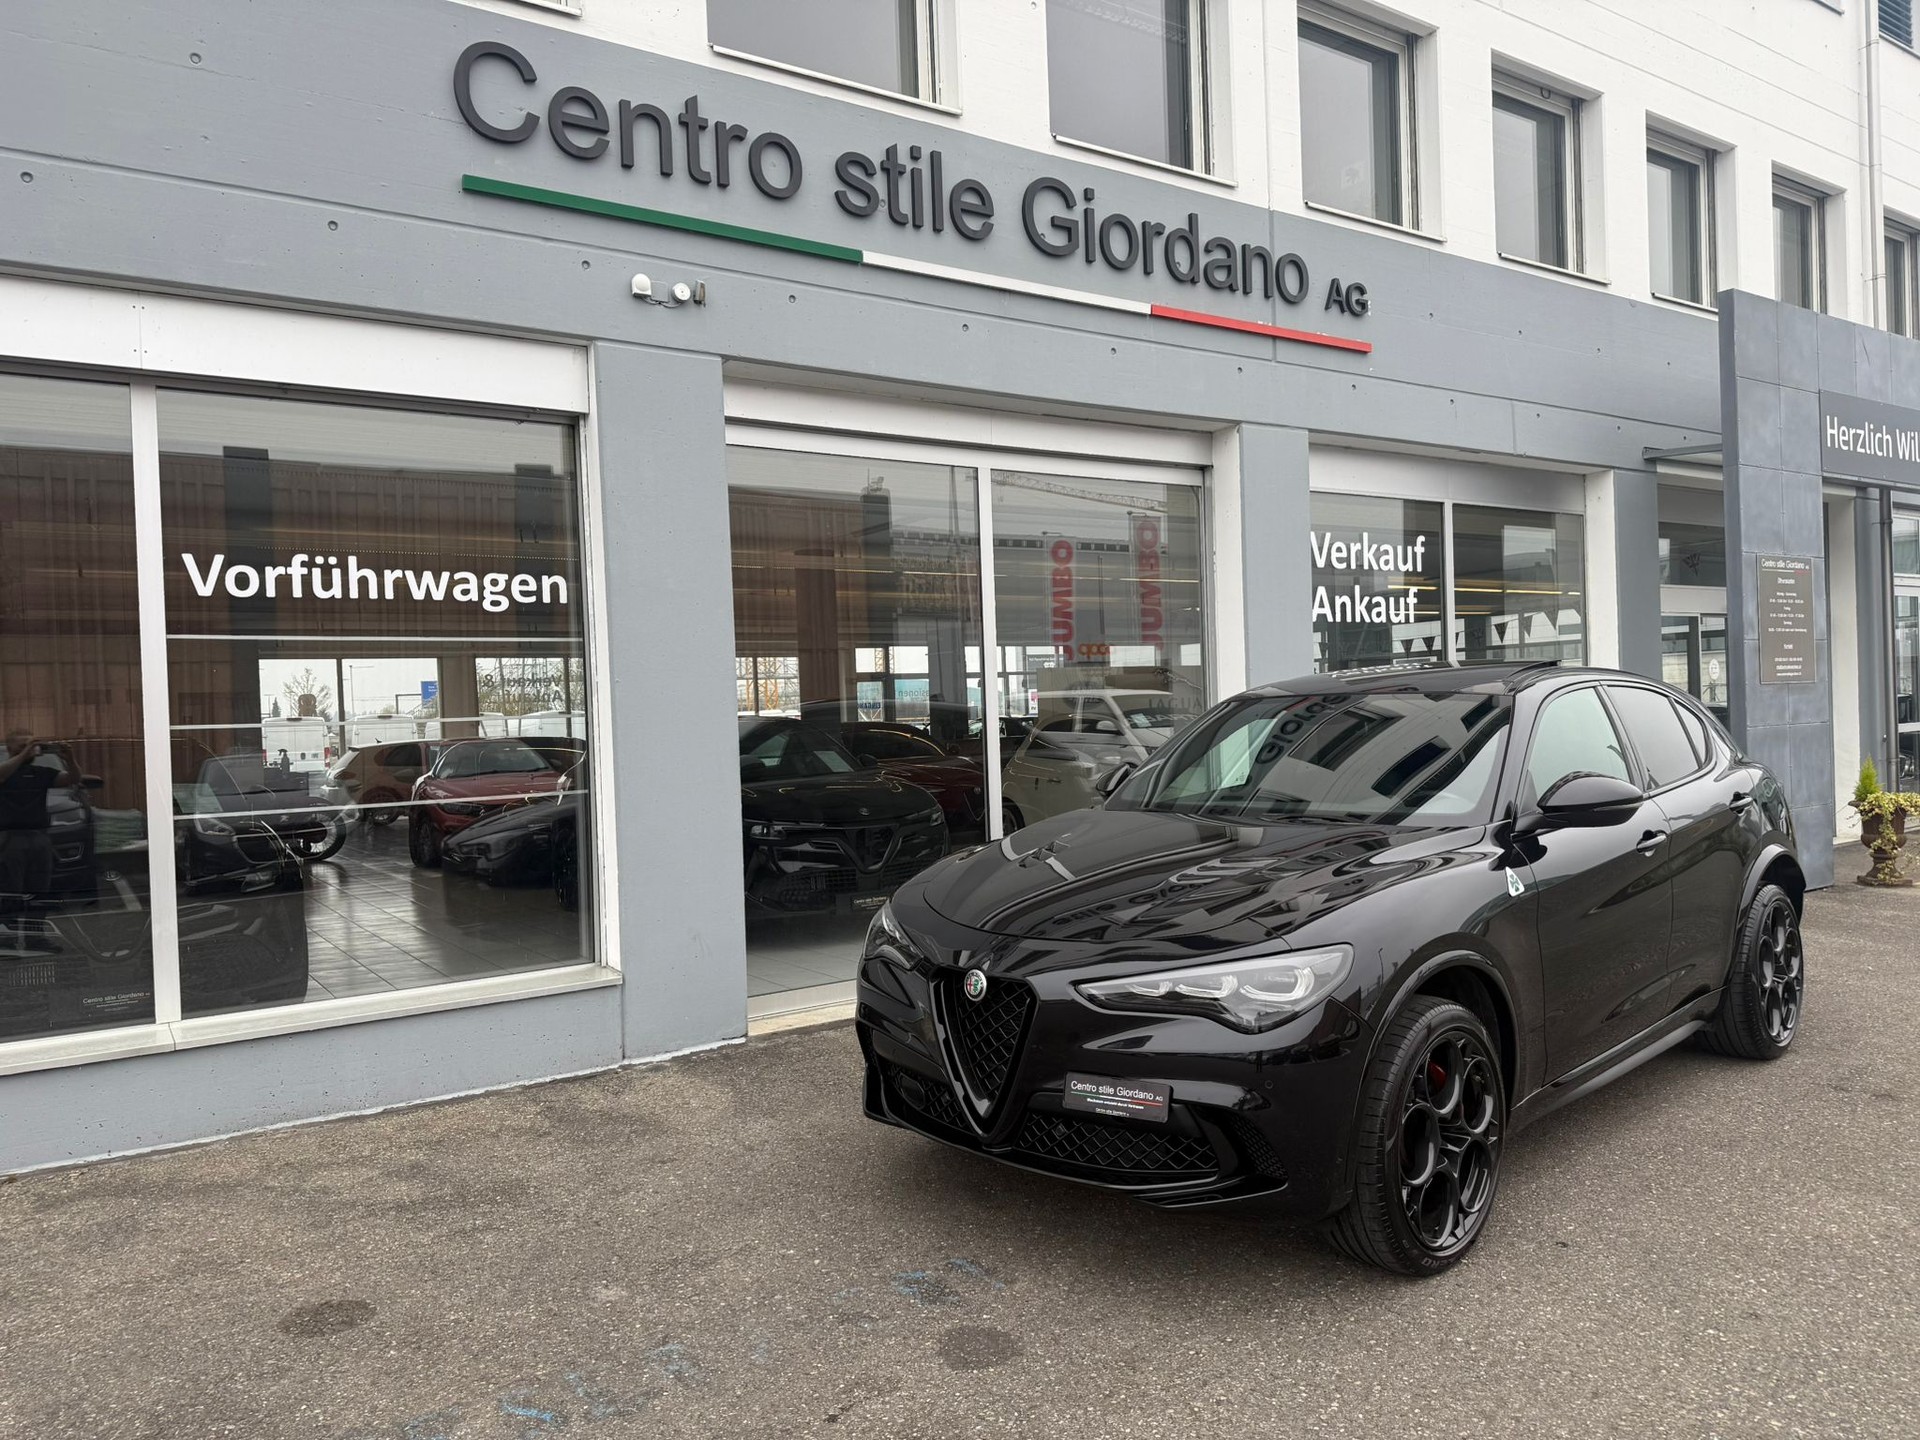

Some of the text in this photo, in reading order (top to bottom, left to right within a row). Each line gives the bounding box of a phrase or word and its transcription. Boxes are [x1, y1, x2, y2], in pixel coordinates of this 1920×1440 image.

[453, 41, 1370, 317] Centro stile Giordano AG
[1826, 415, 1893, 458] Herzlich
[1310, 530, 1426, 573] Verkauf
[181, 552, 569, 613] Vorführwagen
[1311, 585, 1418, 624] Ankauf
[1148, 697, 1203, 710] JAGUA
[1071, 1081, 1097, 1092] Centro
[1098, 1085, 1114, 1095] stile
[1116, 1087, 1154, 1100] Giordano
